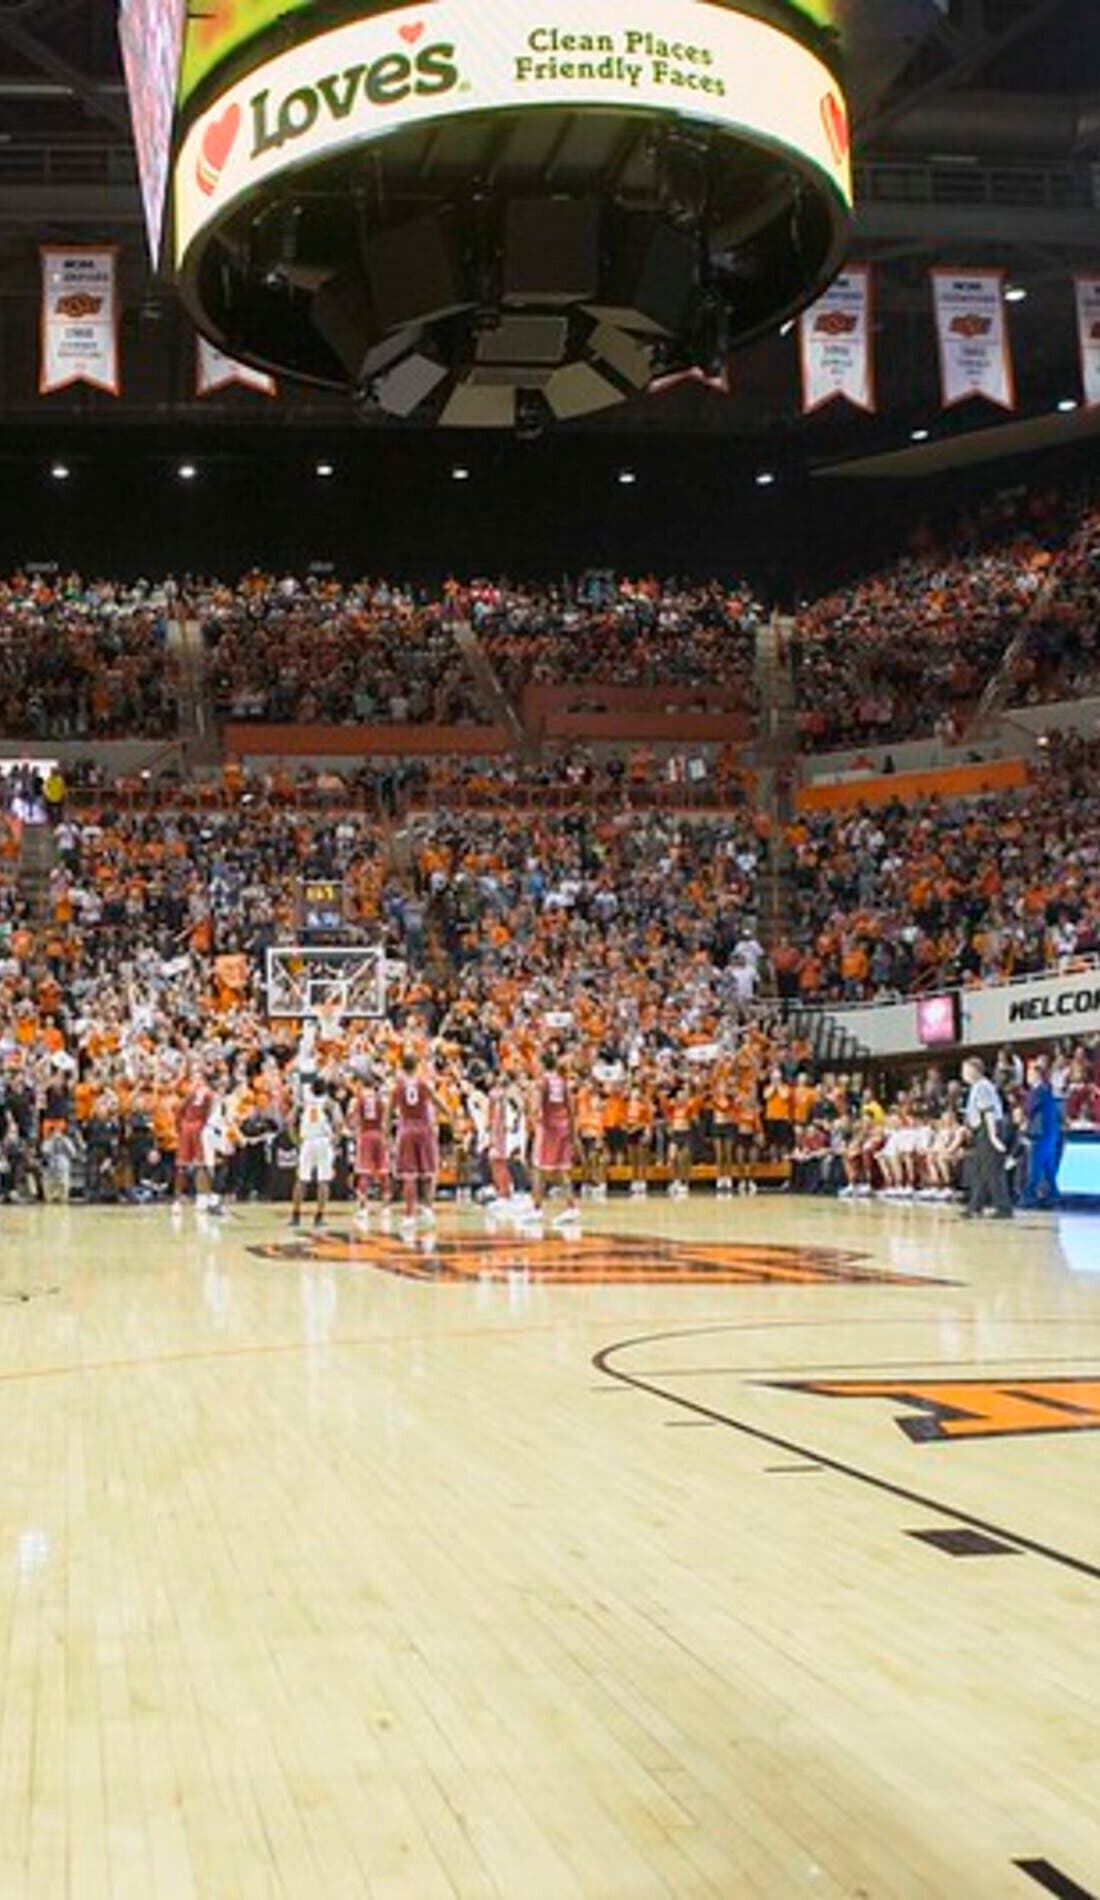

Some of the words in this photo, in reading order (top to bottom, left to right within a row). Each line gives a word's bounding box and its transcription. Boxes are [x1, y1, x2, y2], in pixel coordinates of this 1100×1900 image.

[528, 28, 614, 51] Clean
[625, 31, 713, 66] Places
[515, 57, 642, 87] Friendly
[652, 61, 725, 96] Faces
